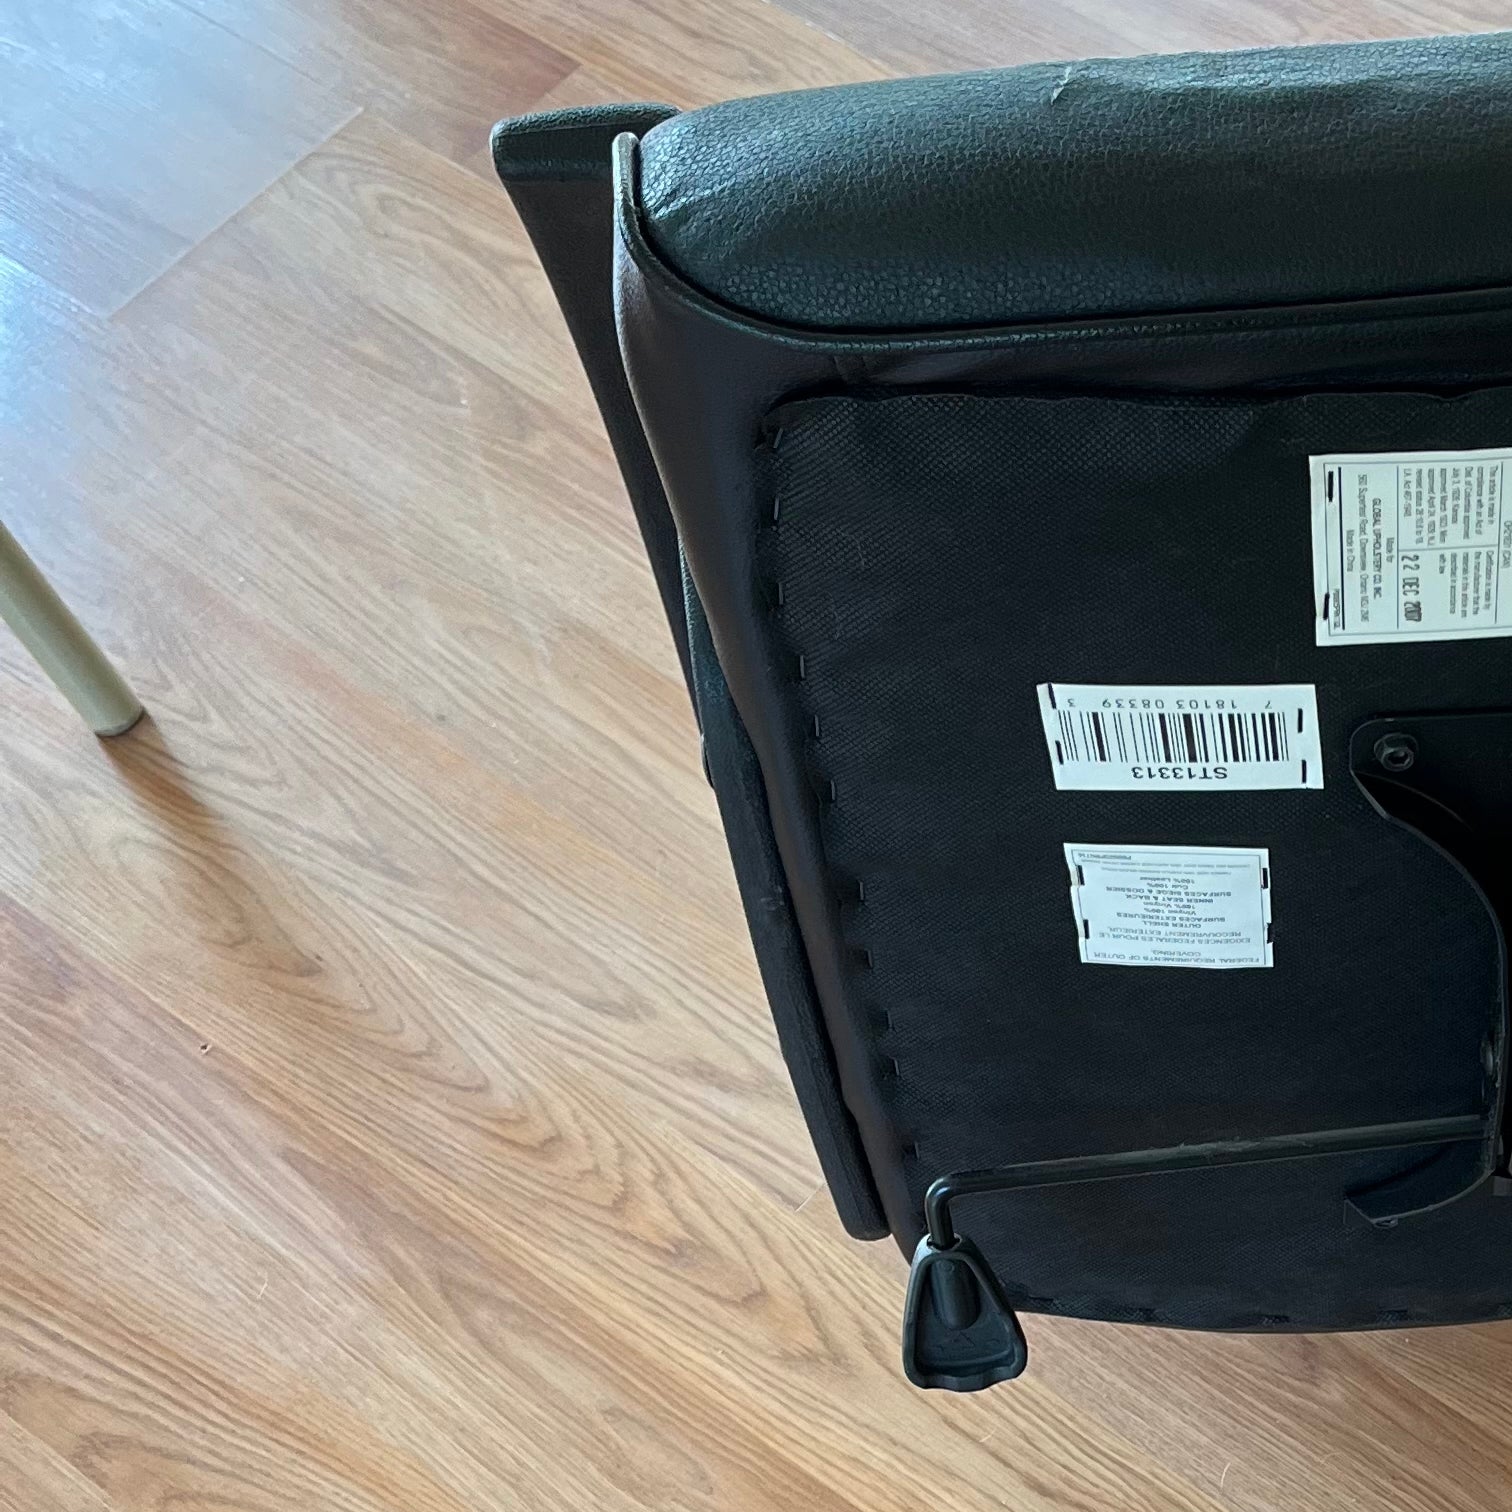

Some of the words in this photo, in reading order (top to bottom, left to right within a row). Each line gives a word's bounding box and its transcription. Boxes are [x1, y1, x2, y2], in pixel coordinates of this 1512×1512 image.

[1372, 497, 1381, 526] GLOBAL
[1345, 529, 1354, 546] Made
[1372, 528, 1381, 572] UPHOLSTERY
[1346, 554, 1355, 572] China
[1402, 576, 1419, 595] DEC
[1067, 698, 1075, 707] 3
[1102, 698, 1164, 709] 08339
[1175, 699, 1237, 709] 18103
[1264, 700, 1272, 709] 7
[1131, 766, 1227, 779] ST13313
[1164, 930, 1241, 939] RECOUVREMENT
[1093, 951, 1125, 959] OUTER
[1142, 955, 1215, 963] REQUIREMENTS
